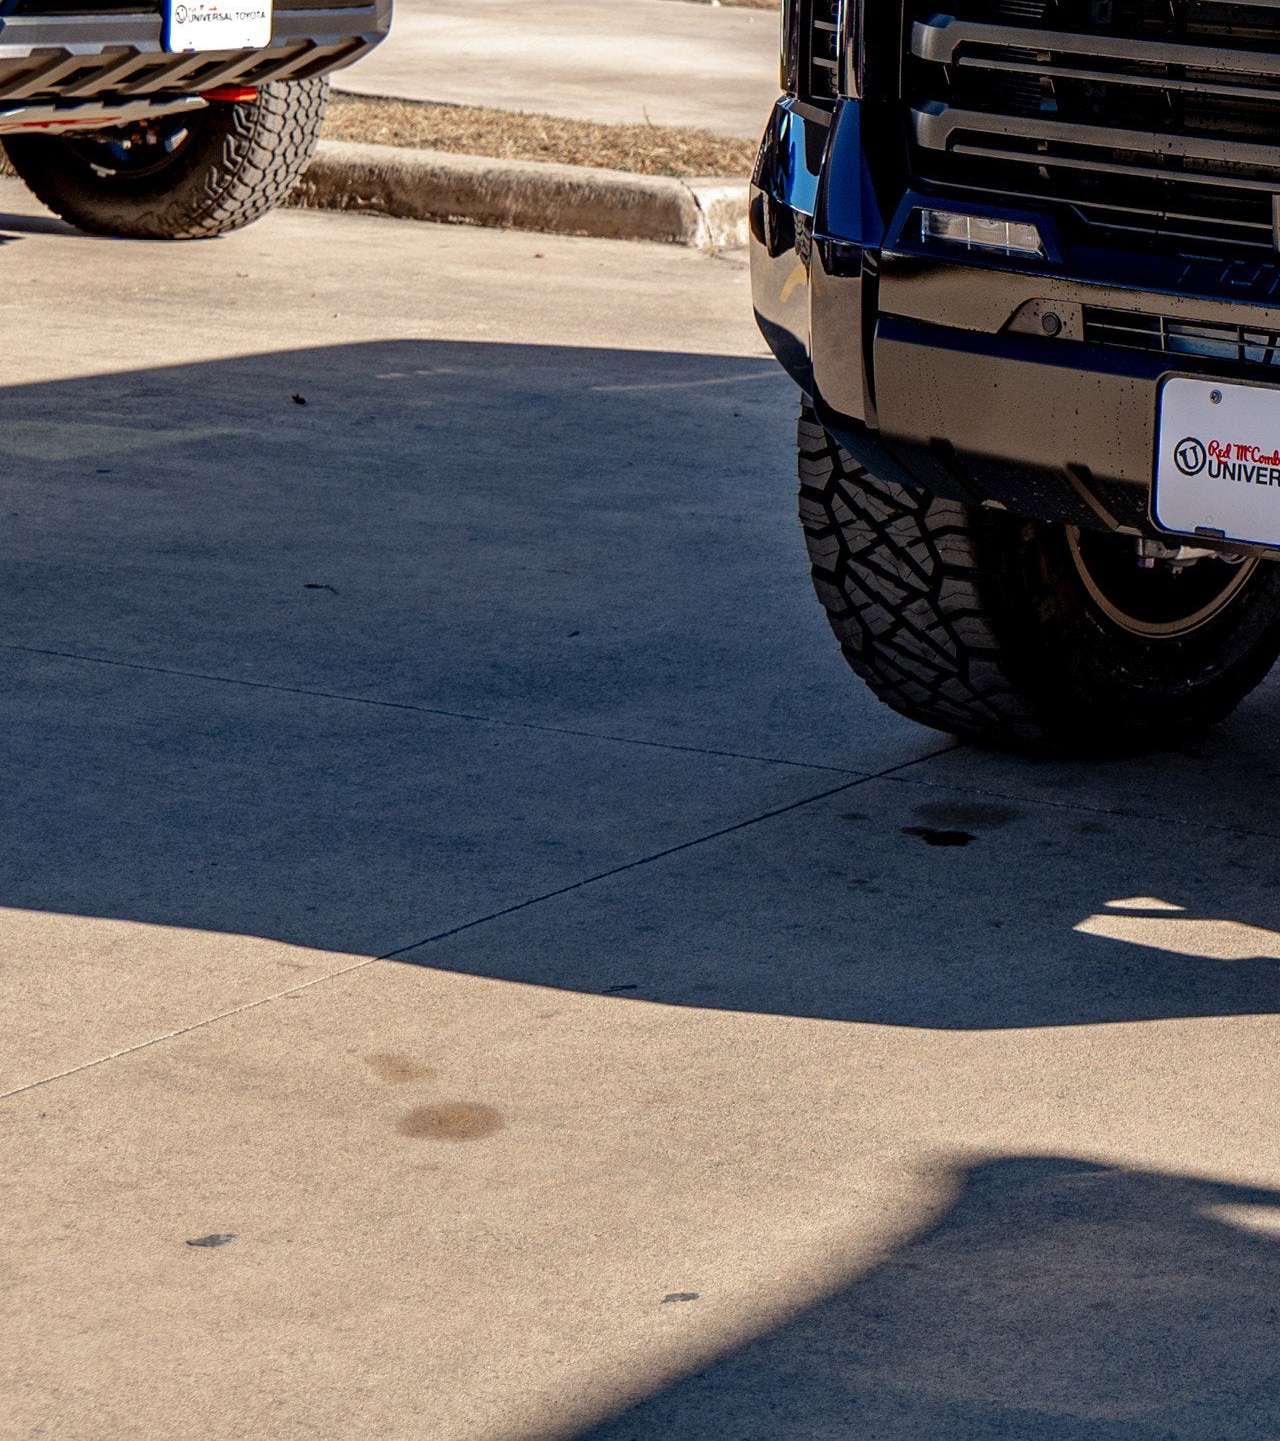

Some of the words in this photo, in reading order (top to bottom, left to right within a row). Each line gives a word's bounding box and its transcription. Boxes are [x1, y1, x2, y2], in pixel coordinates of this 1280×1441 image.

[188, 12, 232, 23] UNIVERSAL
[235, 10, 266, 21] TOYOTA
[1208, 439, 1232, 465] Red
